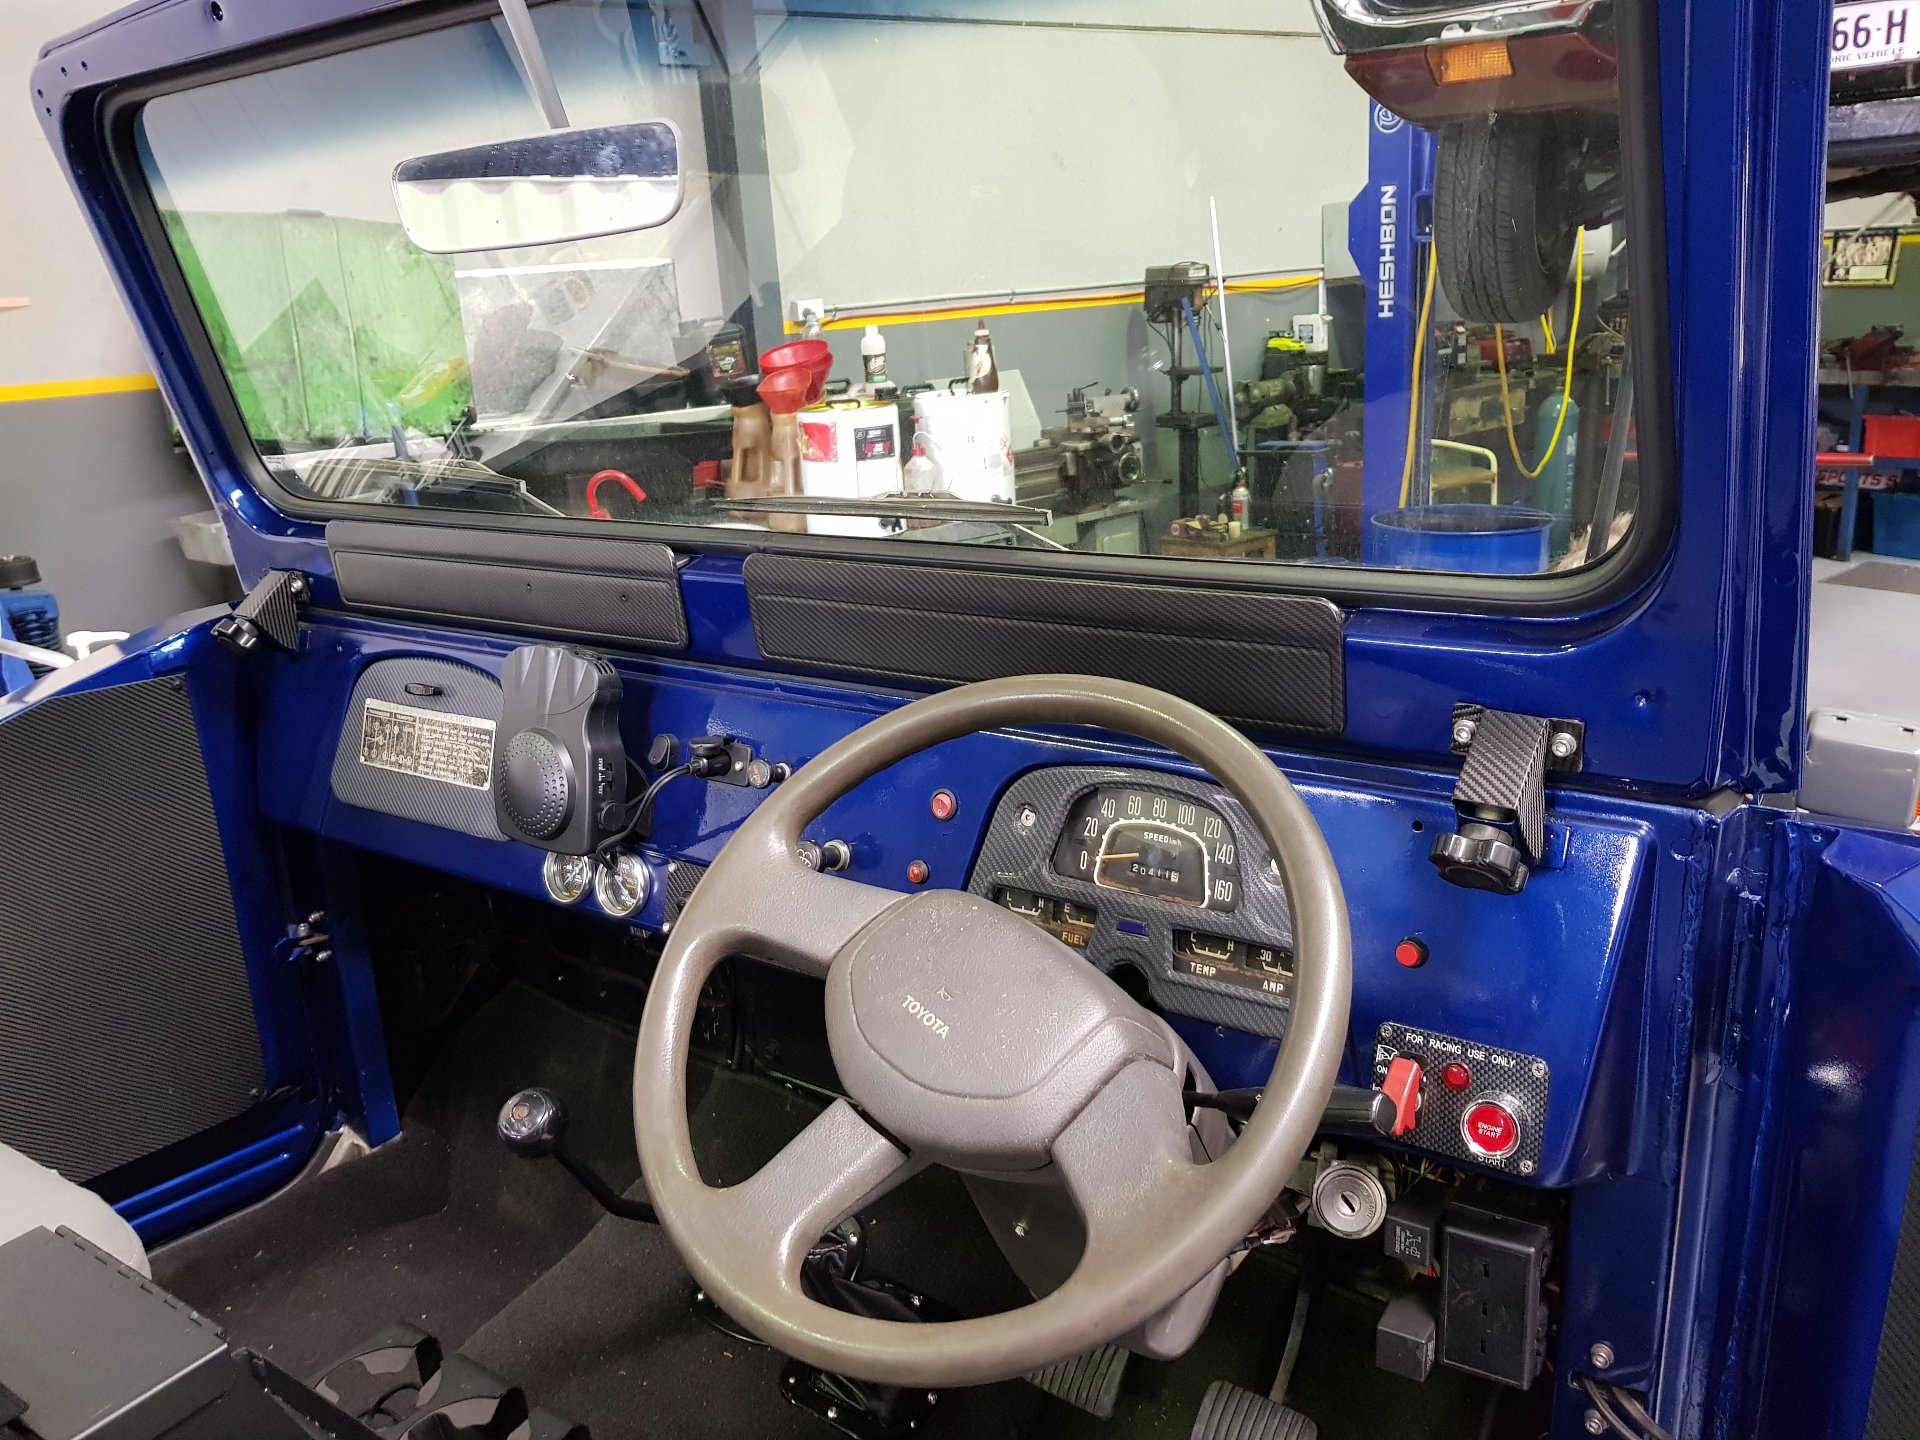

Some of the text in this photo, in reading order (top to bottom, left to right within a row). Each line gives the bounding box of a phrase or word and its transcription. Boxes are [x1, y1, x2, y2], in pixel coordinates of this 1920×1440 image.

[1831, 53, 1853, 63] RIC
[1378, 184, 1397, 318] HESHBON
[1101, 799, 1116, 818] 40
[1127, 796, 1142, 816] 60
[1152, 799, 1167, 818] 80
[1177, 805, 1196, 826] 100
[1083, 816, 1098, 837] 20
[1203, 816, 1222, 839] 120
[1143, 831, 1169, 843] SPEED
[1079, 851, 1088, 870] 0
[1214, 841, 1234, 865] 140
[1213, 879, 1233, 902] 160
[1038, 898, 1045, 908] H
[1064, 903, 1071, 913] E
[1061, 931, 1085, 946] FUEL
[1227, 940, 1235, 951] H
[1190, 961, 1216, 977] TEMP
[1262, 980, 1284, 994] AMP
[902, 994, 950, 1040] TOYOTA
[1405, 1033, 1516, 1068] FOR RACING USE ONLY
[1376, 1064, 1388, 1075] ON
[1477, 1121, 1503, 1134] ENGINE
[1477, 1128, 1501, 1139] START
